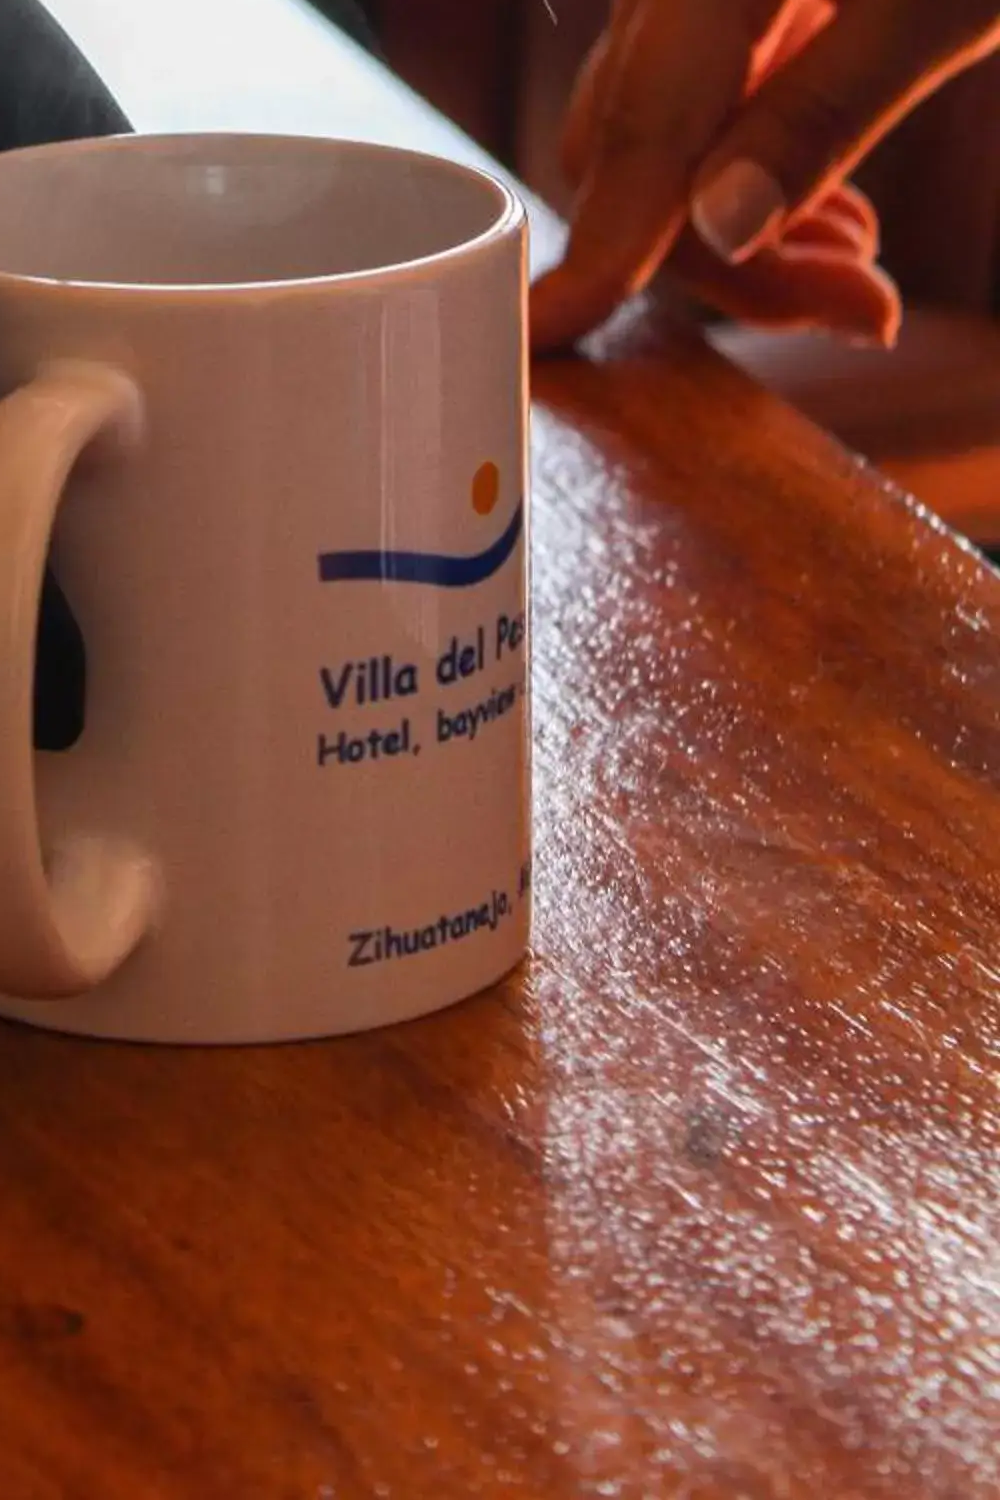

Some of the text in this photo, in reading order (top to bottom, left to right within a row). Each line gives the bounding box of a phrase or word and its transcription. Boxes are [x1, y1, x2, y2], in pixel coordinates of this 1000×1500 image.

[320, 654, 418, 709] Villa
[436, 625, 484, 685] del
[317, 717, 422, 766] Hotel,
